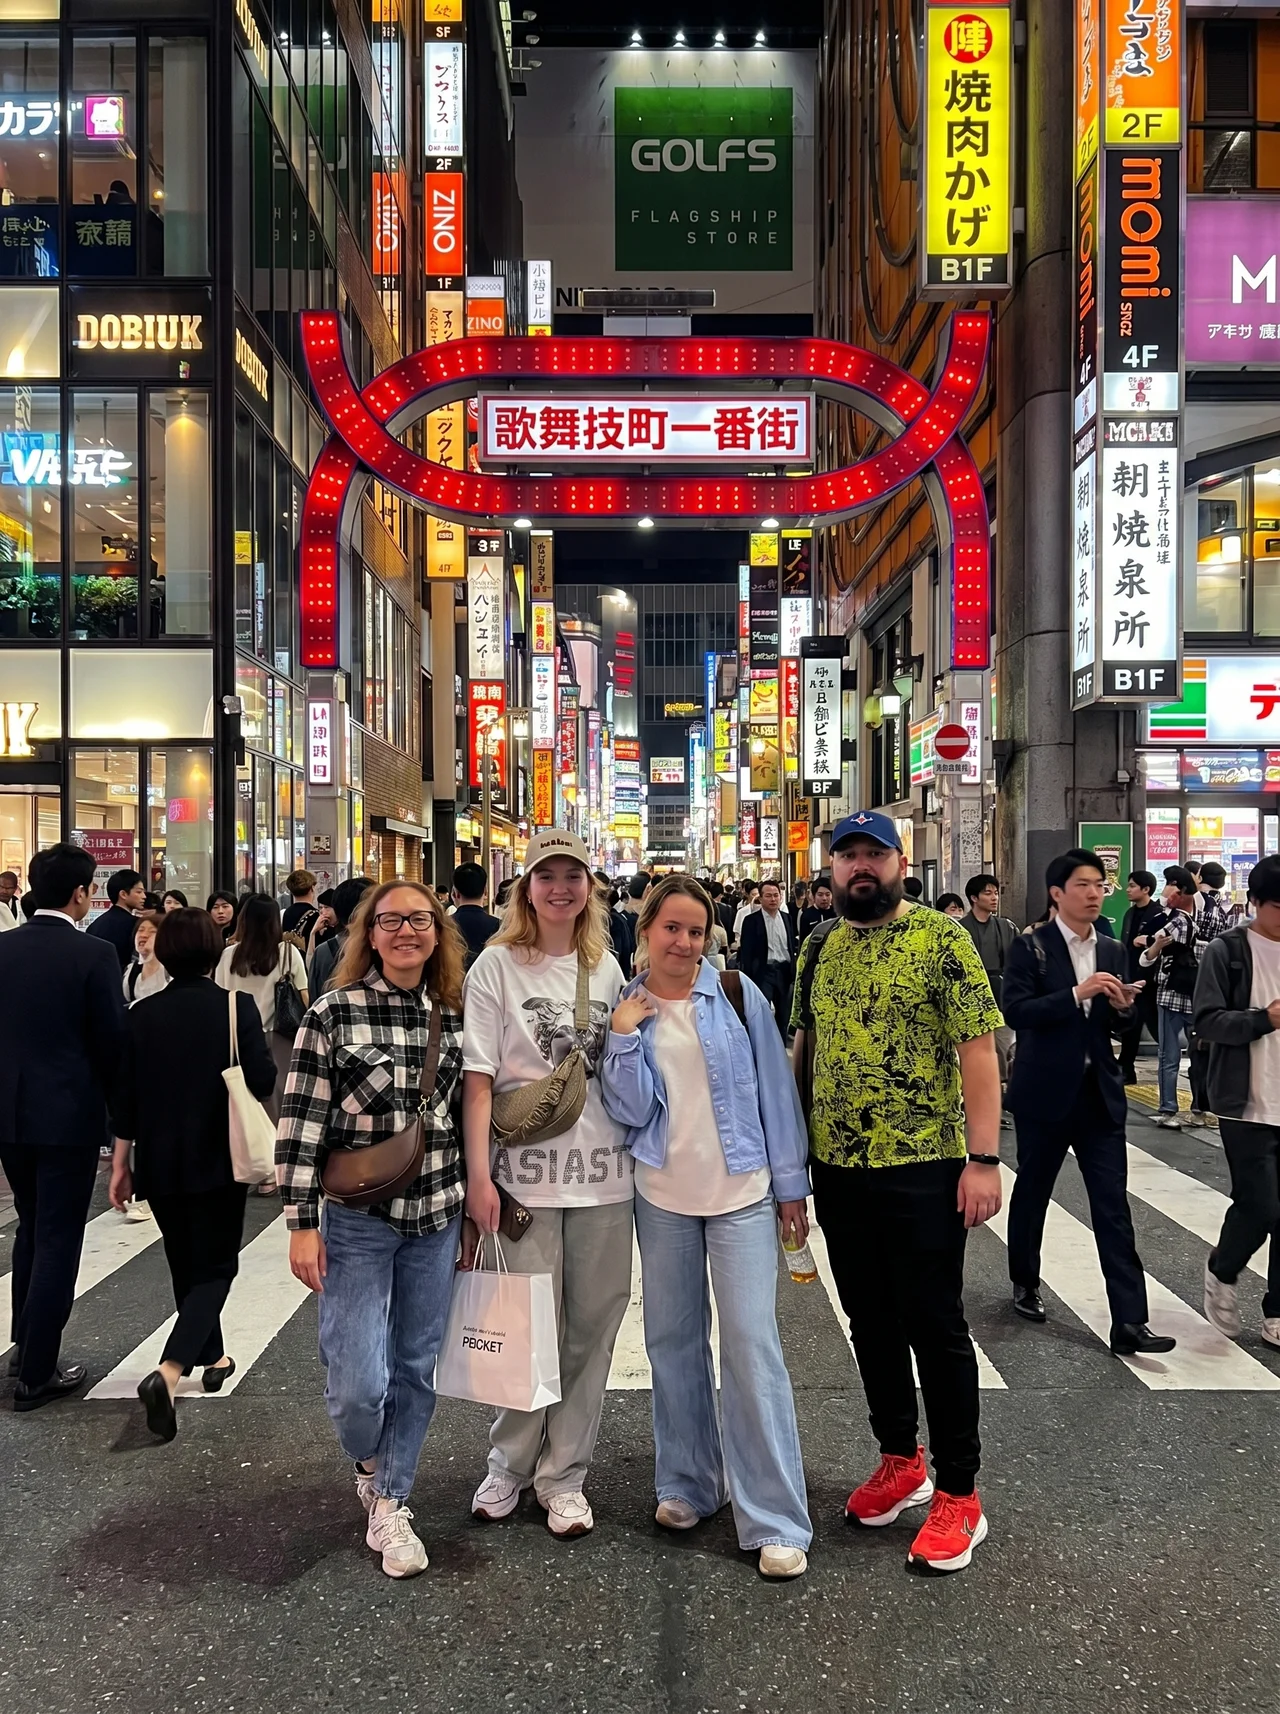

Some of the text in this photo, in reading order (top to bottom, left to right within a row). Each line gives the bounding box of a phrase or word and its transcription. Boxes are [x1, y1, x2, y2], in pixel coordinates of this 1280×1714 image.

[1122, 113, 1163, 138] 2F
[631, 138, 777, 172] GOLFS
[944, 69, 992, 248] 焼肉かげ
[1081, 126, 1094, 167] 2F
[436, 159, 452, 171] 2F
[433, 189, 455, 253] ZINO
[631, 209, 778, 223] FLAGSHIP
[1120, 158, 1171, 297] momi
[687, 231, 778, 244] STORE
[1079, 173, 1094, 321] momi
[941, 258, 994, 282] B1F
[437, 278, 452, 289] 1F
[77, 314, 203, 350] DOBIUK
[467, 317, 502, 330] ZINO
[1122, 344, 1159, 368] 4F
[1080, 354, 1092, 385] 4F
[1077, 672, 1092, 698] B1F
[1114, 669, 1165, 691] B1F
[812, 782, 832, 794] BF
